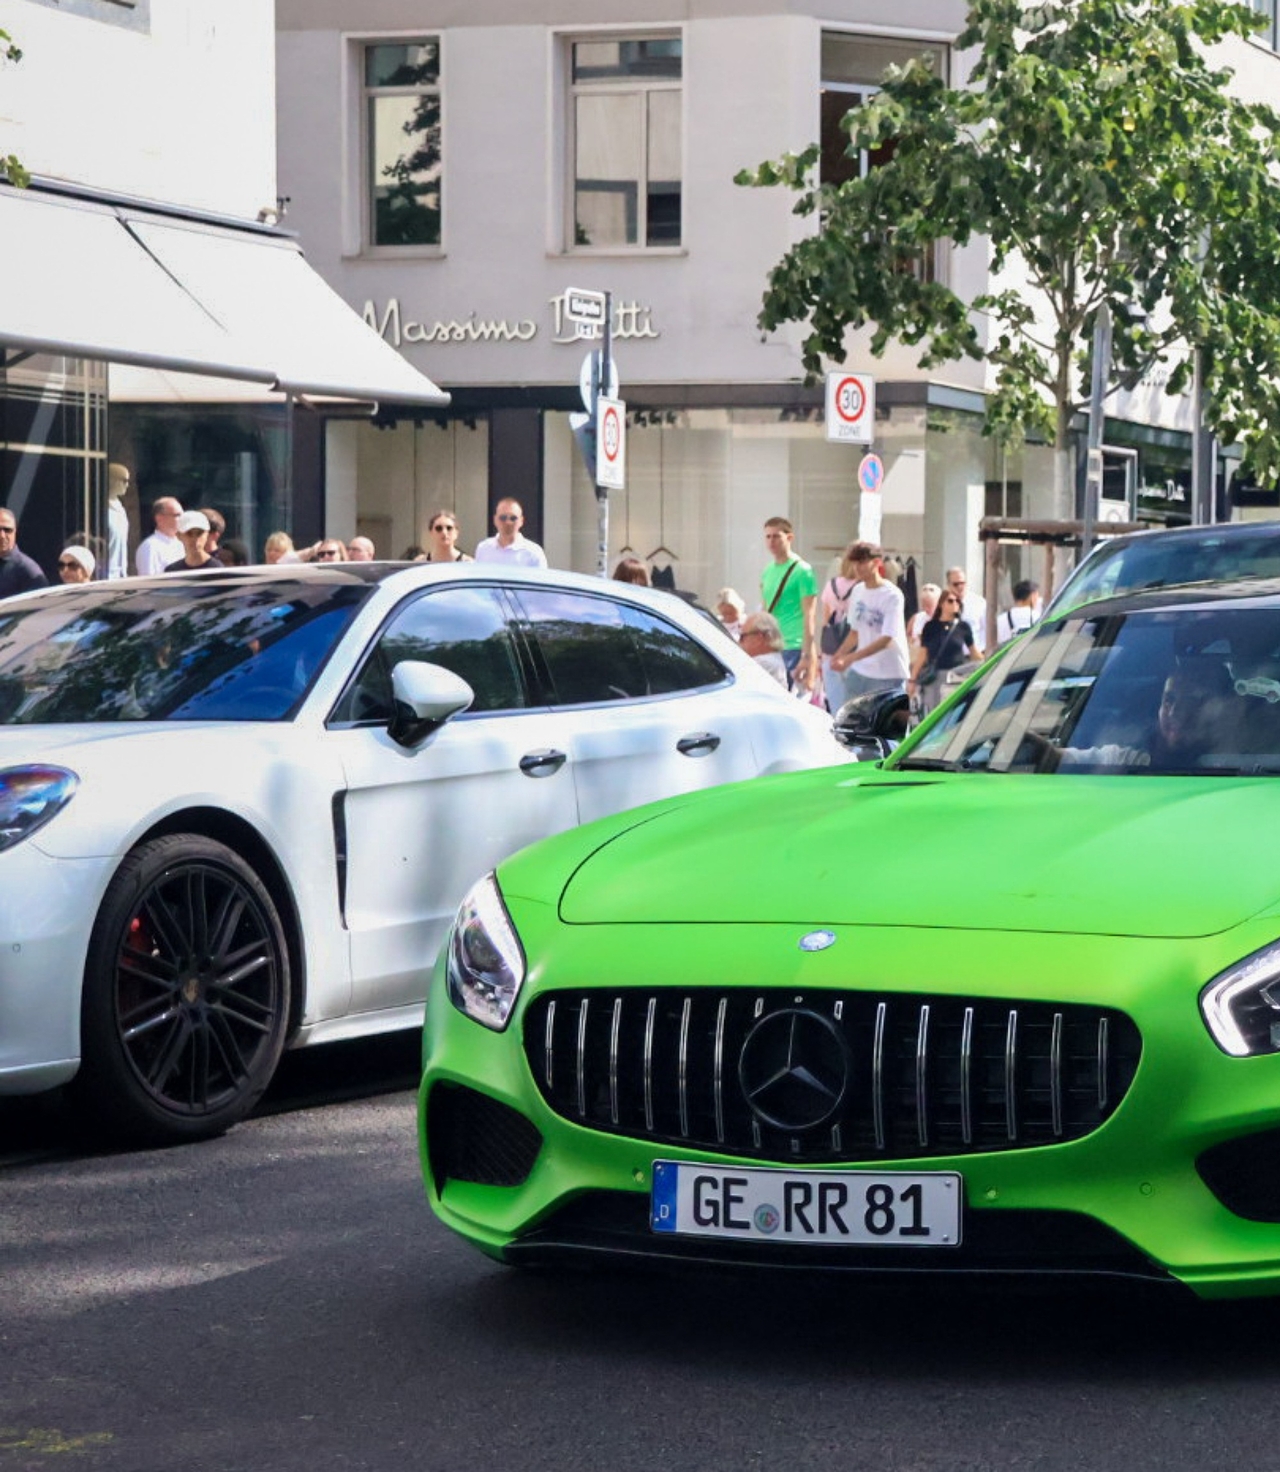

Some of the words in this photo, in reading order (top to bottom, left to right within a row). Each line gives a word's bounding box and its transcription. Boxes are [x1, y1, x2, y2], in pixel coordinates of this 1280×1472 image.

[361, 298, 537, 347] Massimo
[842, 389, 860, 411] 30
[838, 425, 861, 437] ZONE
[660, 1204, 669, 1219] D
[693, 1175, 750, 1230] GE
[783, 1181, 849, 1234] RR
[864, 1183, 930, 1236] 81
